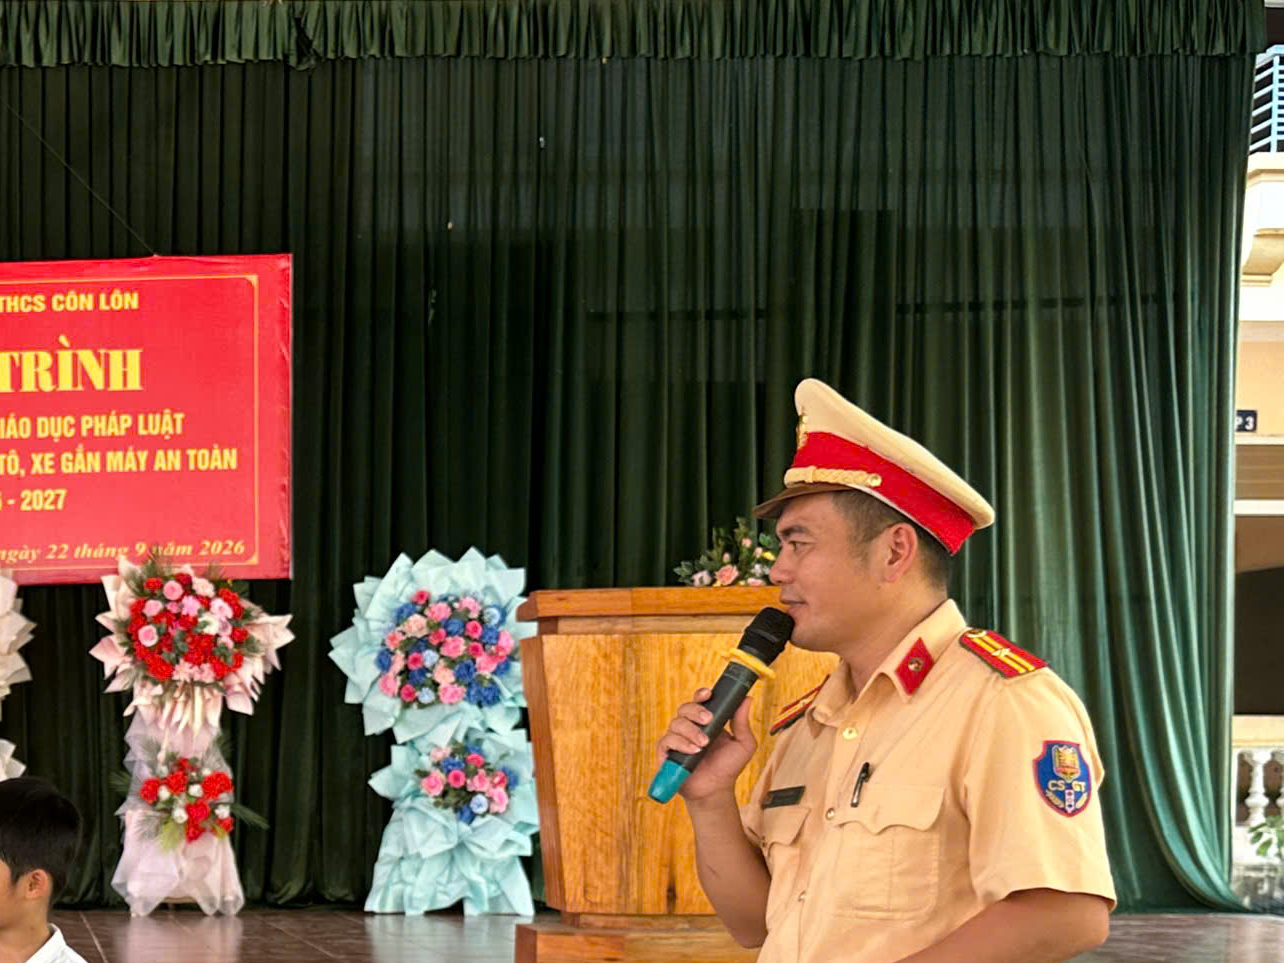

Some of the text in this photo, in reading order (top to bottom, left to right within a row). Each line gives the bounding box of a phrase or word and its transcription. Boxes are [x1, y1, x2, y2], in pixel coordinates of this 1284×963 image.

[51, 289, 94, 312] CÔN
[99, 288, 139, 311] LÔN
[36, 415, 76, 443] DỤC
[81, 409, 132, 437] PHÁP
[137, 408, 186, 440] LUẬT
[30, 452, 56, 475] XE
[106, 445, 149, 473] MÁY
[153, 448, 182, 472] AN
[186, 443, 238, 472] TOÀN
[6, 498, 16, 506] -
[20, 488, 67, 512] 2027
[44, 543, 69, 560] 22
[134, 541, 147, 557] 9
[199, 539, 246, 556] 2026
